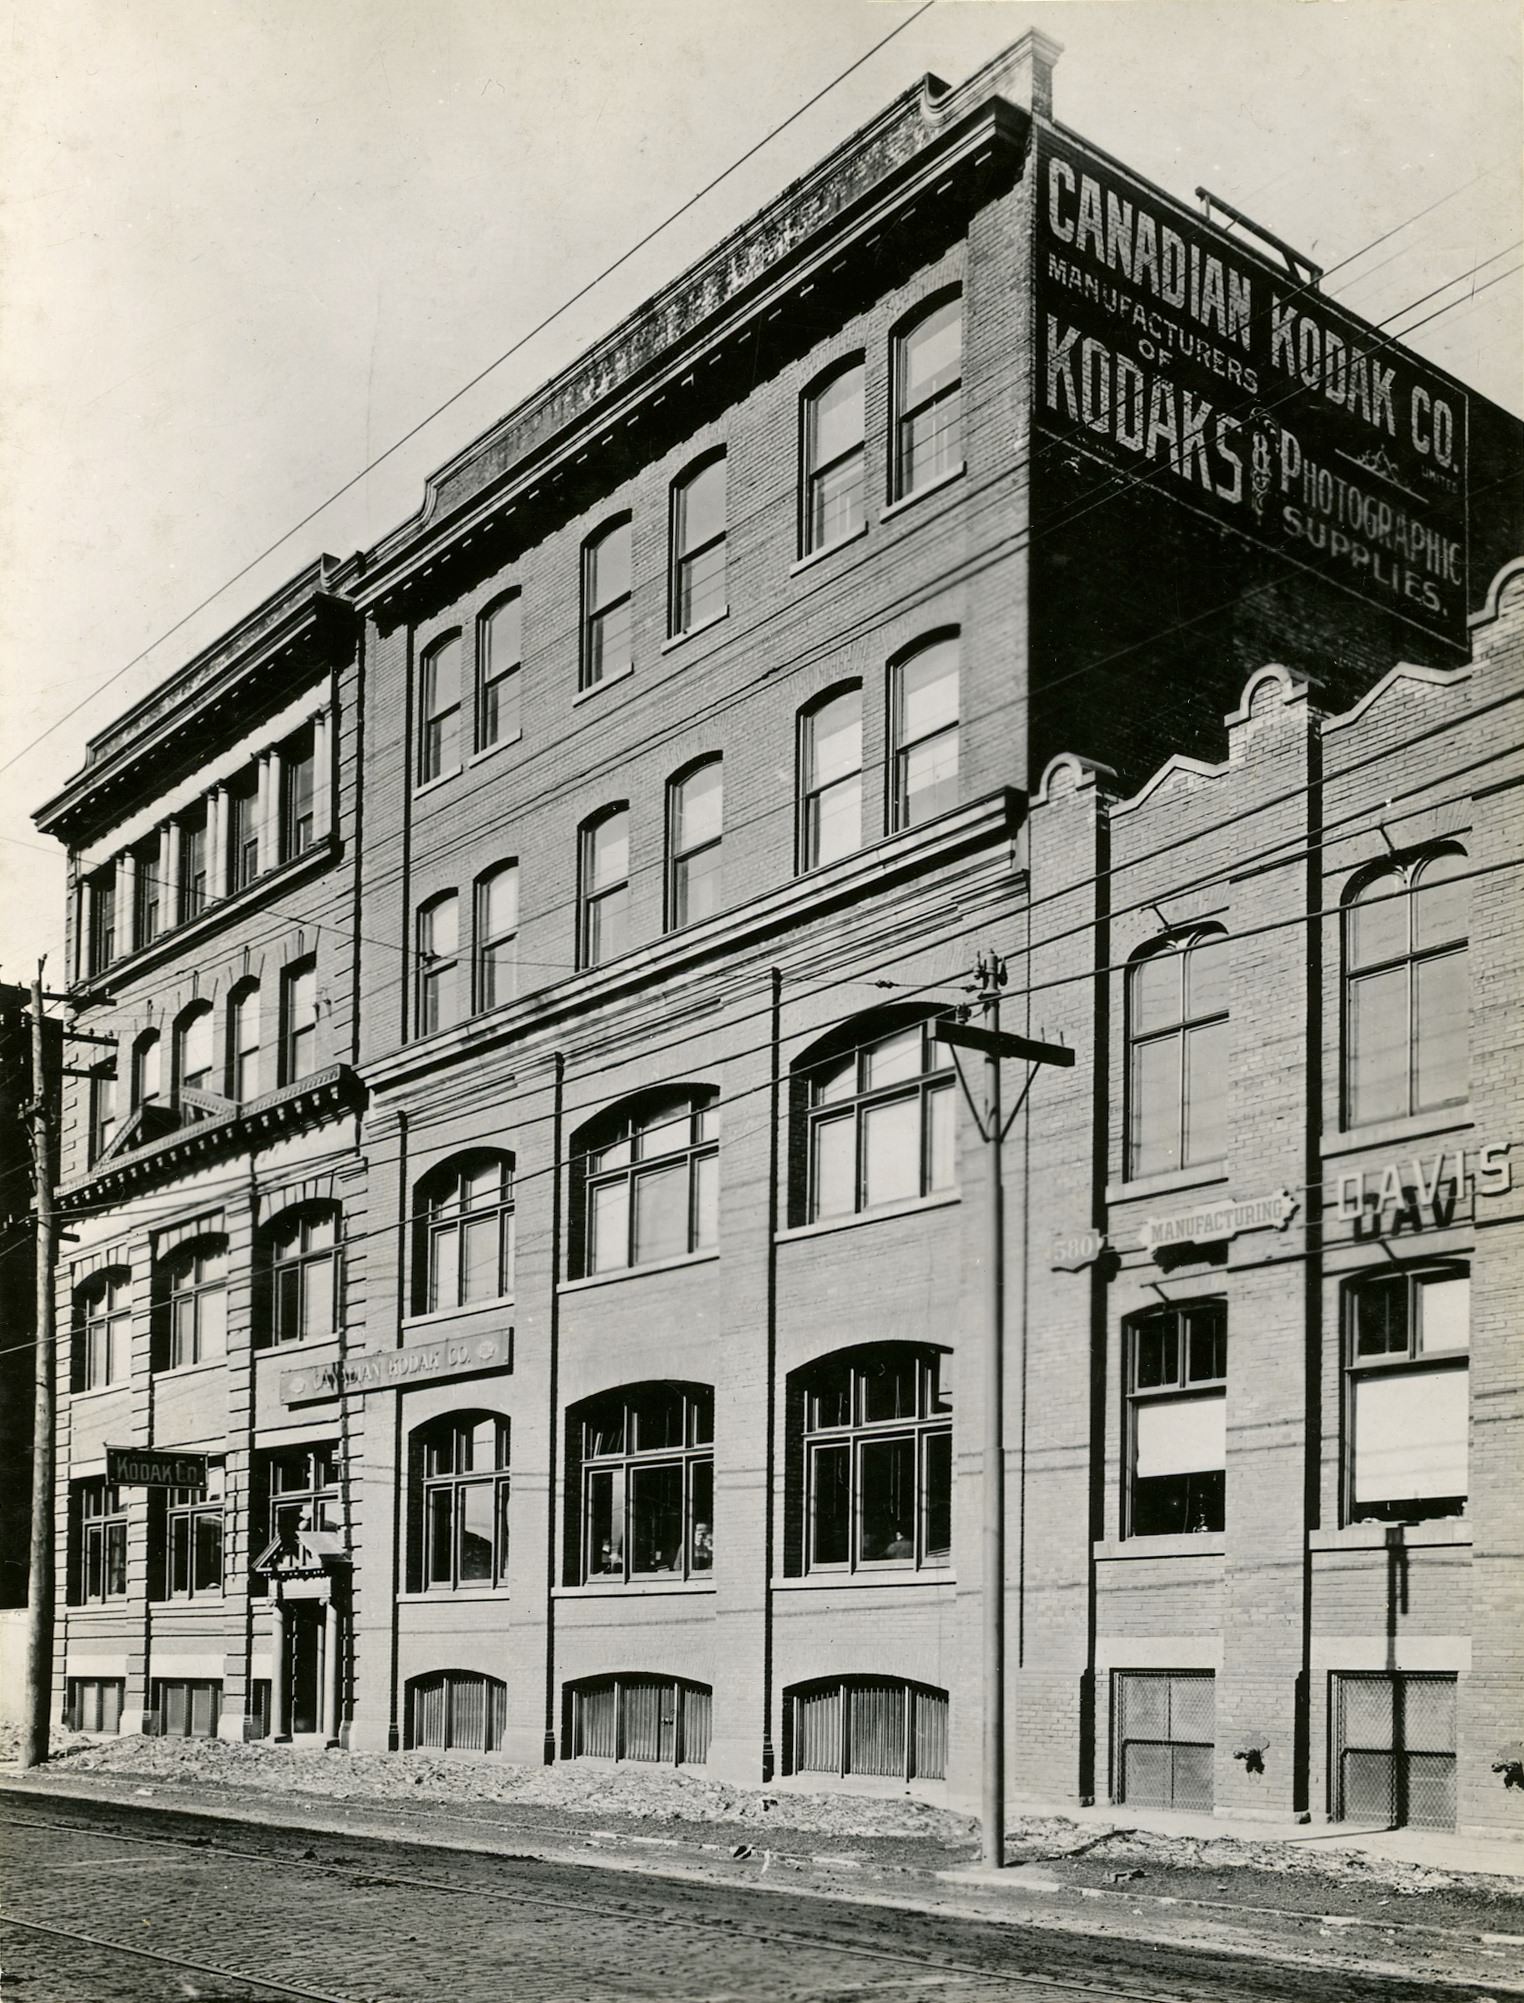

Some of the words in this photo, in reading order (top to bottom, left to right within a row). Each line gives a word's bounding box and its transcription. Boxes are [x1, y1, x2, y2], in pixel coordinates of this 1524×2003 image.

[1048, 156, 1252, 351] CANADIAN
[1271, 292, 1396, 437] KODAK
[1411, 385, 1460, 474] CO.
[1048, 254, 1258, 395] MANUFACTURERS
[1138, 340, 1171, 368] OF
[1046, 313, 1242, 505] KODAKS
[1280, 428, 1462, 586] PHOTOGRAPHIC
[1282, 507, 1448, 617] SUPPLIES.
[1337, 1141, 1511, 1221] DAVIS
[1053, 1236, 1092, 1261] 580
[1151, 1195, 1283, 1244] MANUFACTURING
[388, 1351, 440, 1377] KODAK
[117, 1456, 172, 1484] KODAK
